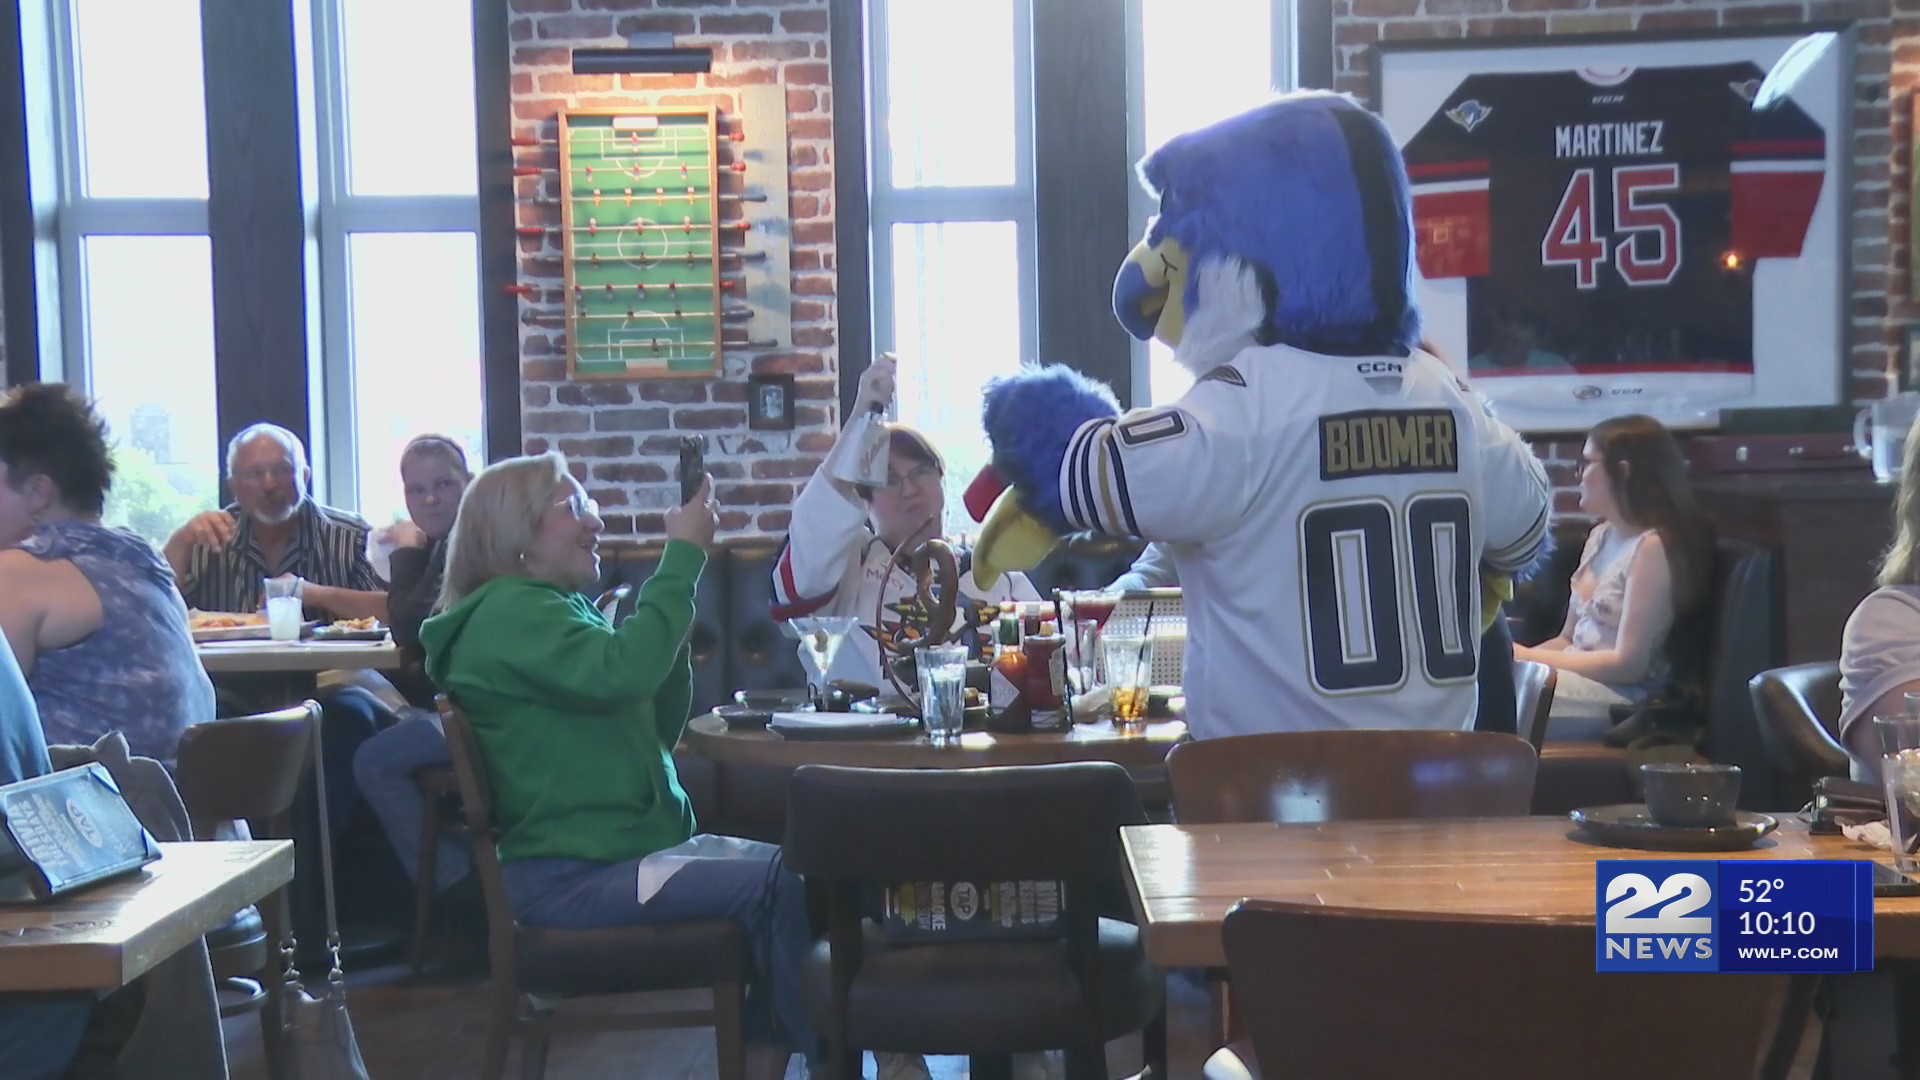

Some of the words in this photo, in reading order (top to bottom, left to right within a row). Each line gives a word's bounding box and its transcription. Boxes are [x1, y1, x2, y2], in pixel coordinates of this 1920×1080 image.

[1555, 121, 1664, 158] MARTINEZ
[1541, 162, 1682, 289] 45
[1357, 361, 1402, 373] CCM
[1324, 413, 1454, 474] BOOMER
[1298, 491, 1480, 695] 00
[69, 803, 98, 844] TAP
[957, 887, 970, 914] TAP
